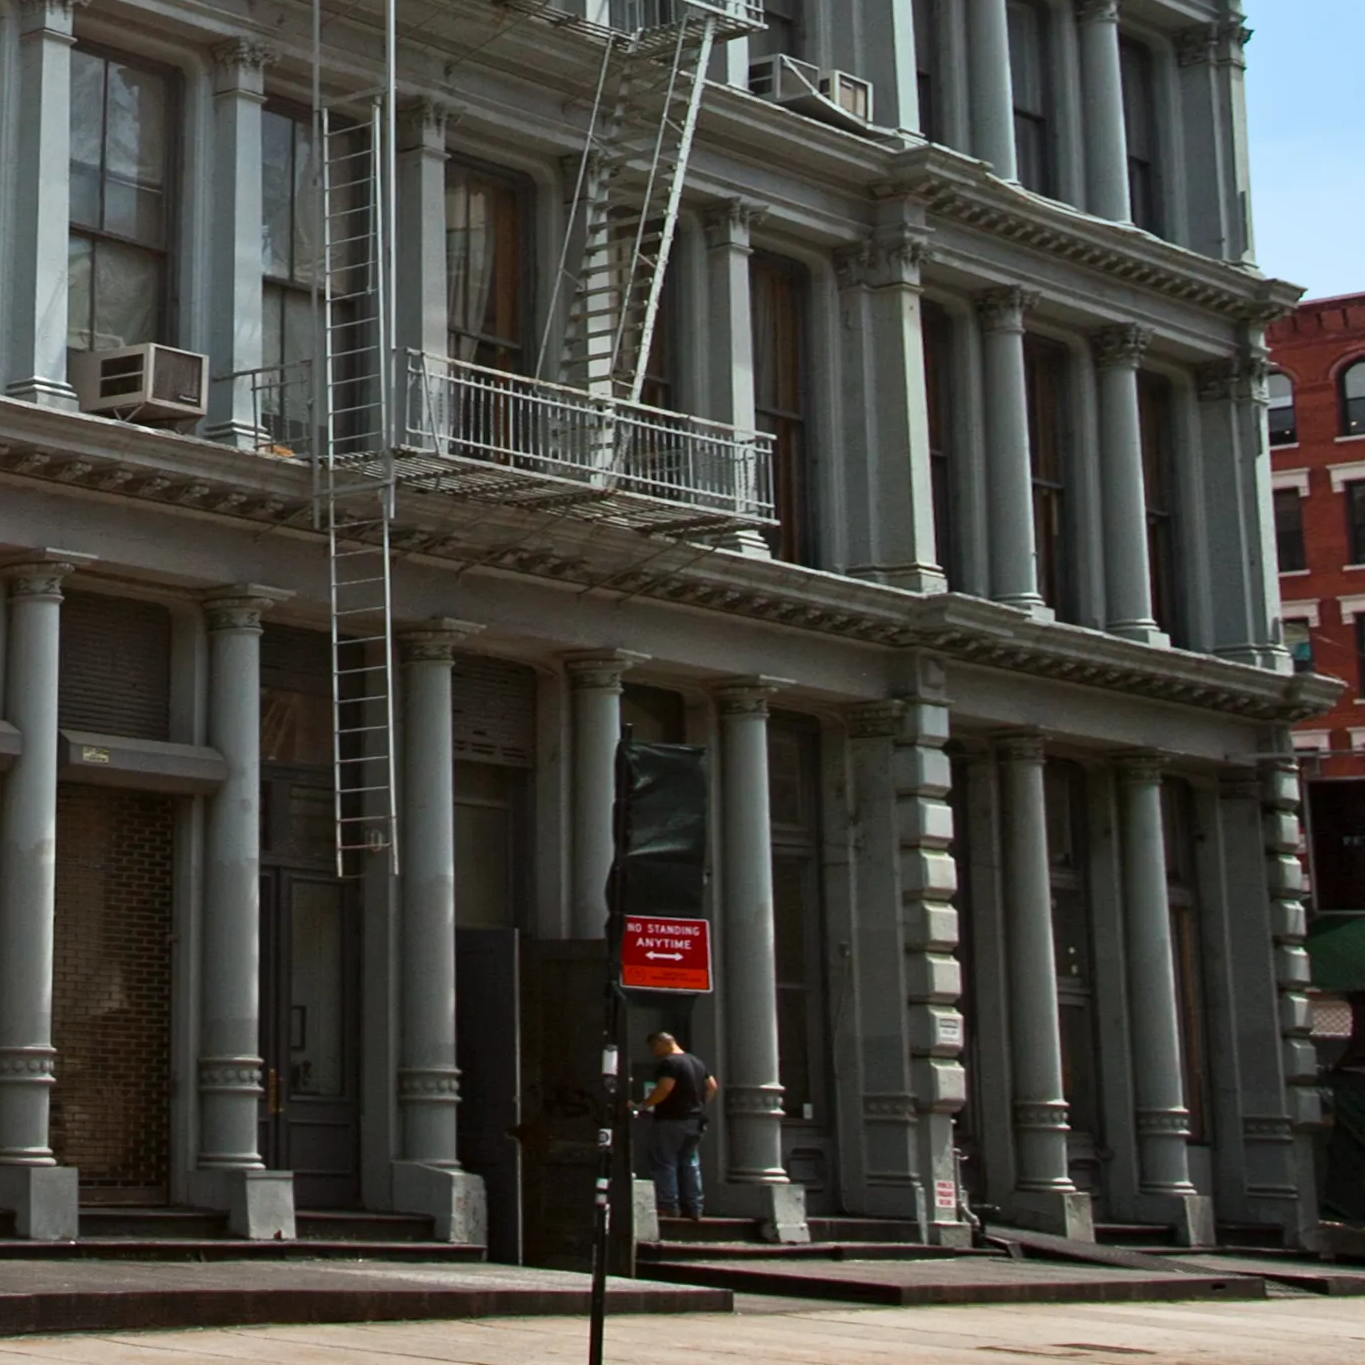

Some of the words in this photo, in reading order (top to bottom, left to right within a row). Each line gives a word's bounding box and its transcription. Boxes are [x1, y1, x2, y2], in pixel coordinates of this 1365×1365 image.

[626, 922, 642, 933] NO
[647, 923, 701, 937] STANDING
[635, 937, 692, 950] ANYTIME
